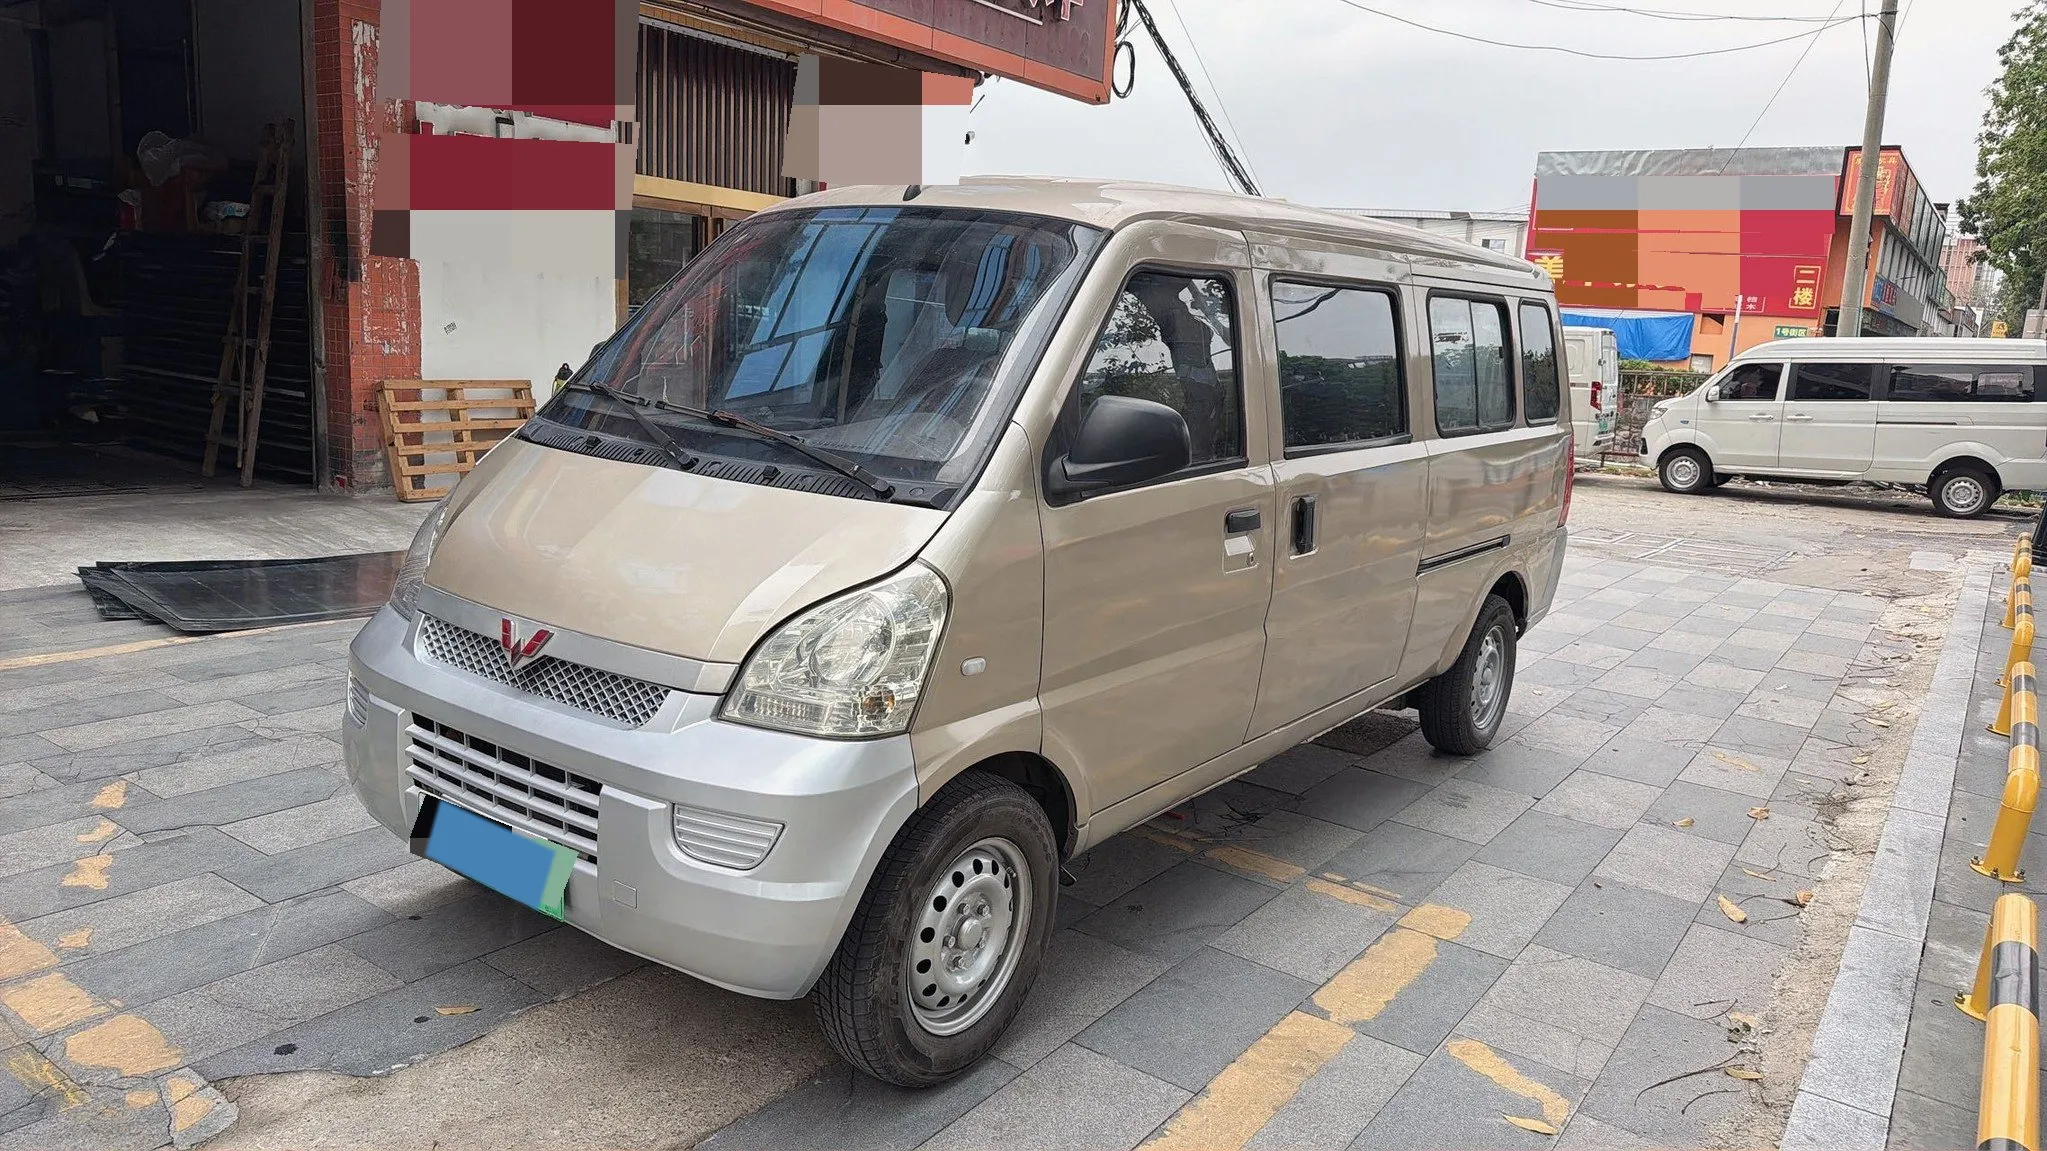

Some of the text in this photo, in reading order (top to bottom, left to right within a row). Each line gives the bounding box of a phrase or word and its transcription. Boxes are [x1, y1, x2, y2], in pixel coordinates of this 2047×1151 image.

[1793, 269, 1816, 306] 二楼
[1776, 327, 1807, 337] 1号街区
